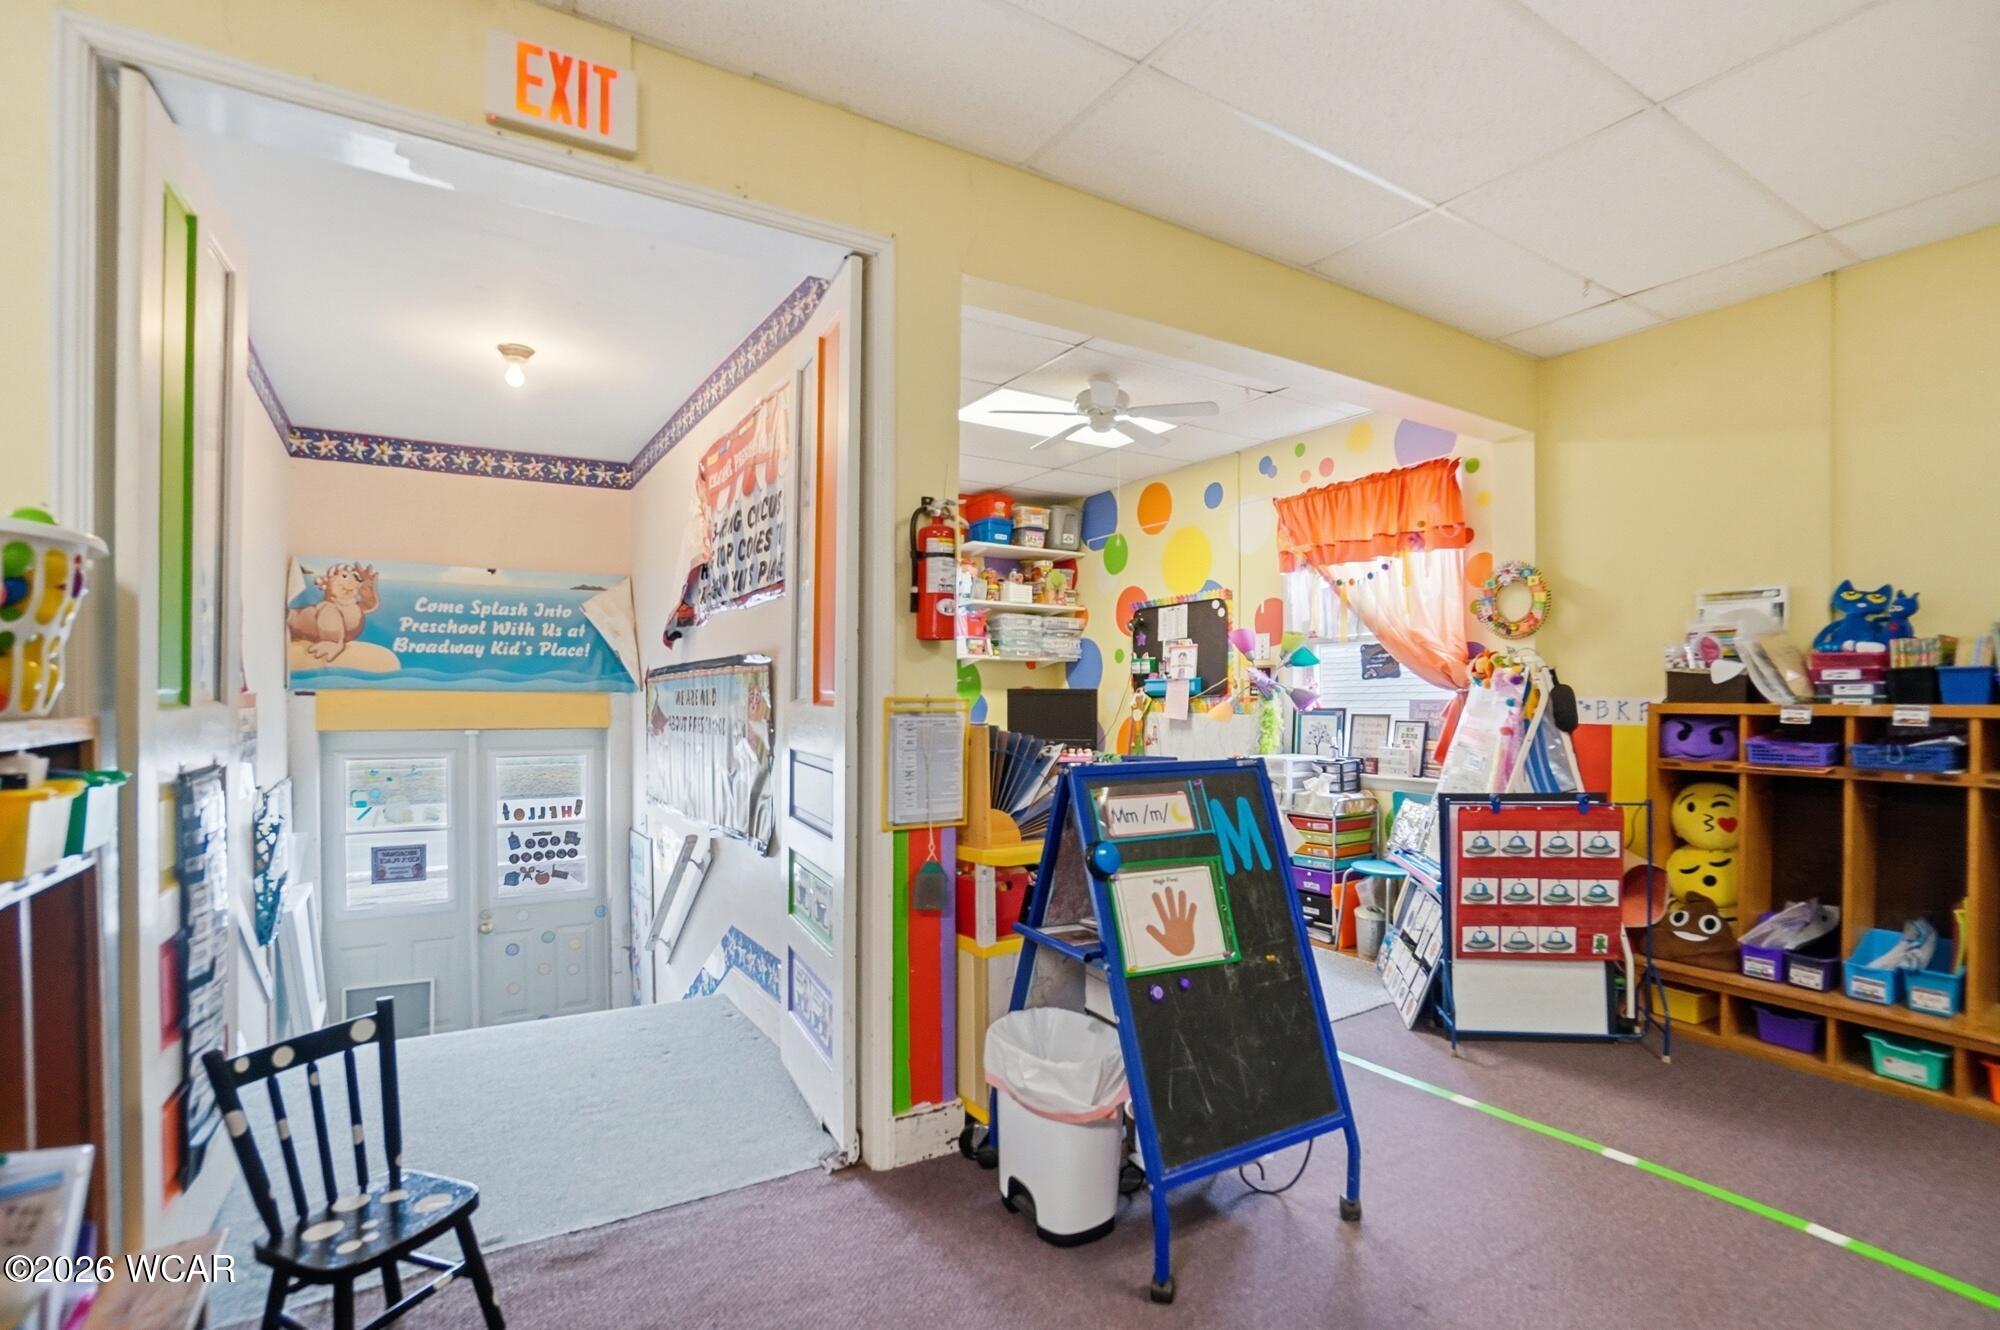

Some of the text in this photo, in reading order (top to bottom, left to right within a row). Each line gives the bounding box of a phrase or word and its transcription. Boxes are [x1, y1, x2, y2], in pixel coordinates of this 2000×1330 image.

[516, 40, 617, 135] EXIT
[415, 596, 572, 618] Come Splash Into
[399, 616, 586, 638] Preschool With Us at
[393, 637, 590, 657] Broadway Kid's Place!
[1111, 809, 1138, 824] Mm
[1209, 796, 1272, 876] M
